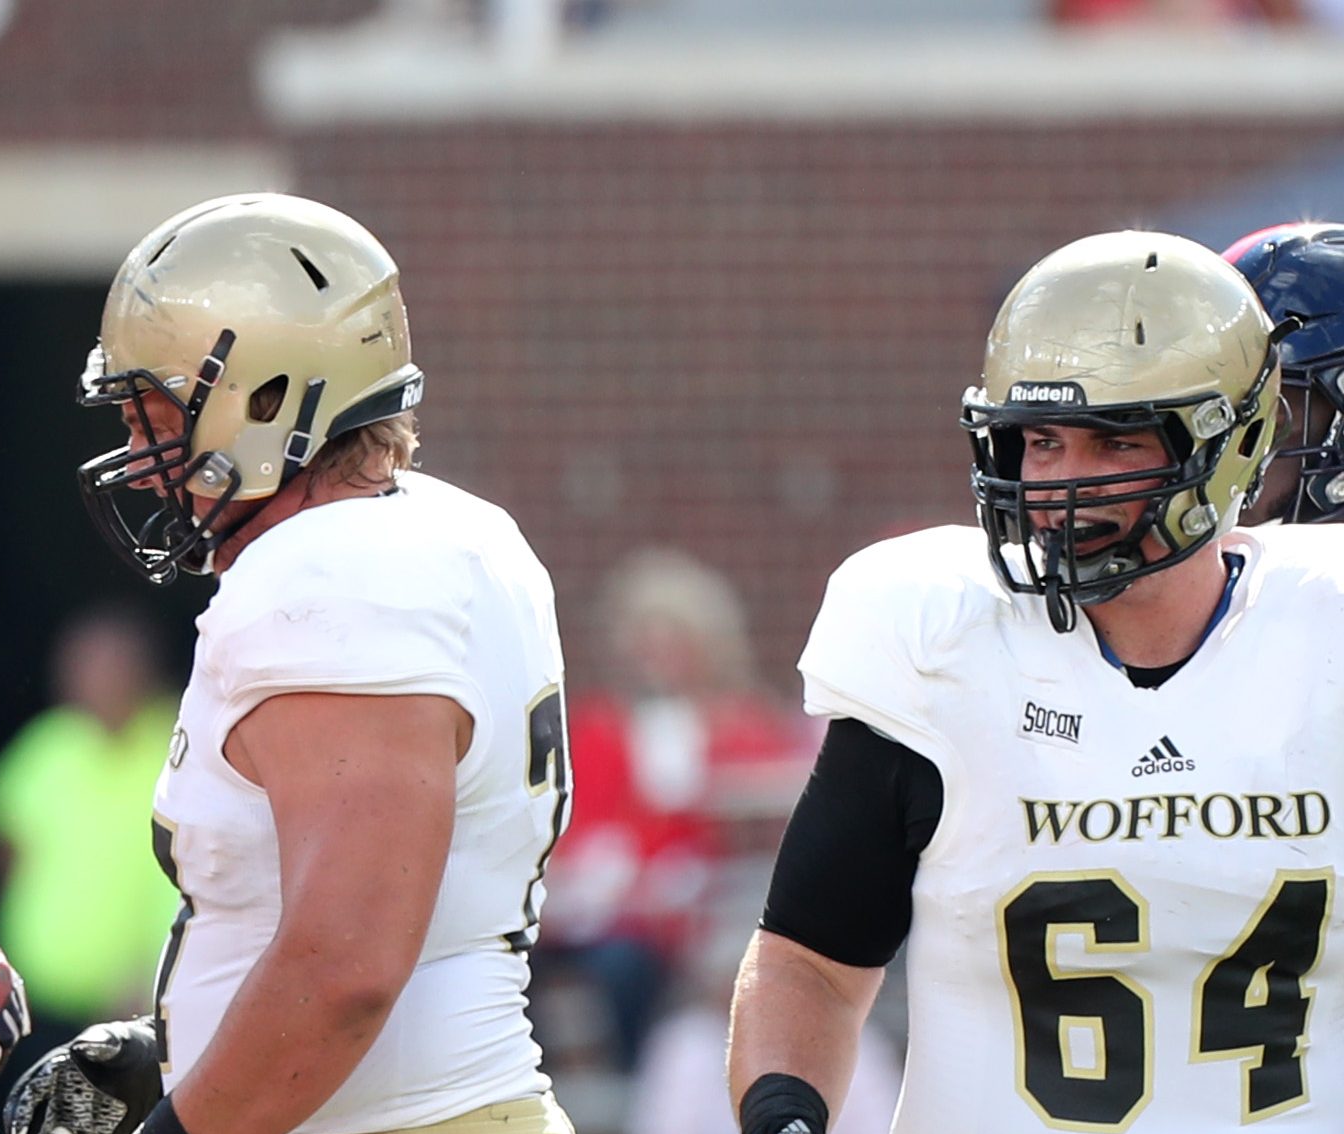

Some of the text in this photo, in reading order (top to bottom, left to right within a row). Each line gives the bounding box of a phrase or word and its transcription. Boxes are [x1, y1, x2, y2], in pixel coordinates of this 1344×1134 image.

[1010, 384, 1075, 402] Riddell
[1131, 757, 1196, 778] adidas
[1017, 790, 1332, 845] WOFFORD
